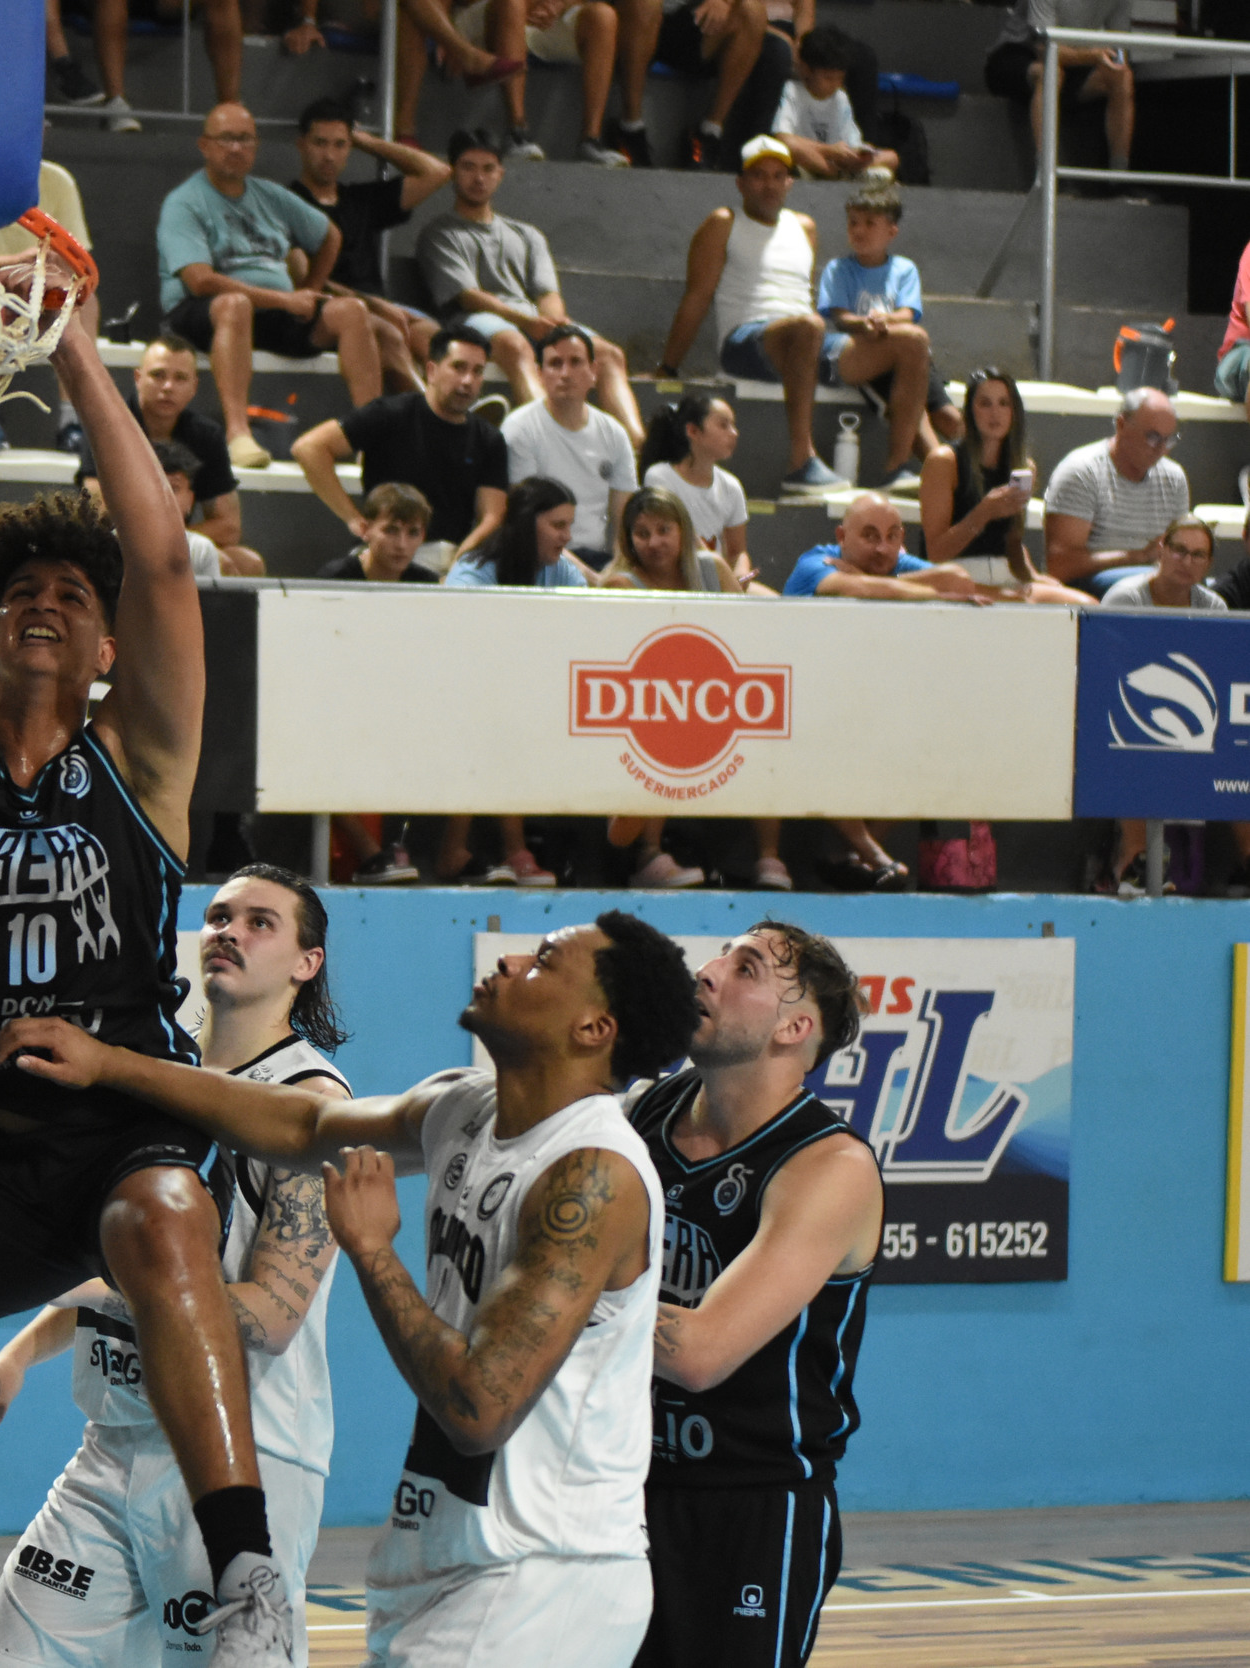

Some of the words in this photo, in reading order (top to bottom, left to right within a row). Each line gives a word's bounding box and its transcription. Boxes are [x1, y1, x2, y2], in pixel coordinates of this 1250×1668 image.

[584, 678, 776, 724] DINCO
[619, 751, 745, 800] SUPERMERCADOS
[8, 912, 57, 986] 10
[946, 1221, 1049, 1258] 615252
[15, 1566, 39, 1580] BANCO
[41, 1576, 87, 1598] SANTIAGO
[29, 1548, 95, 1592] BSE
